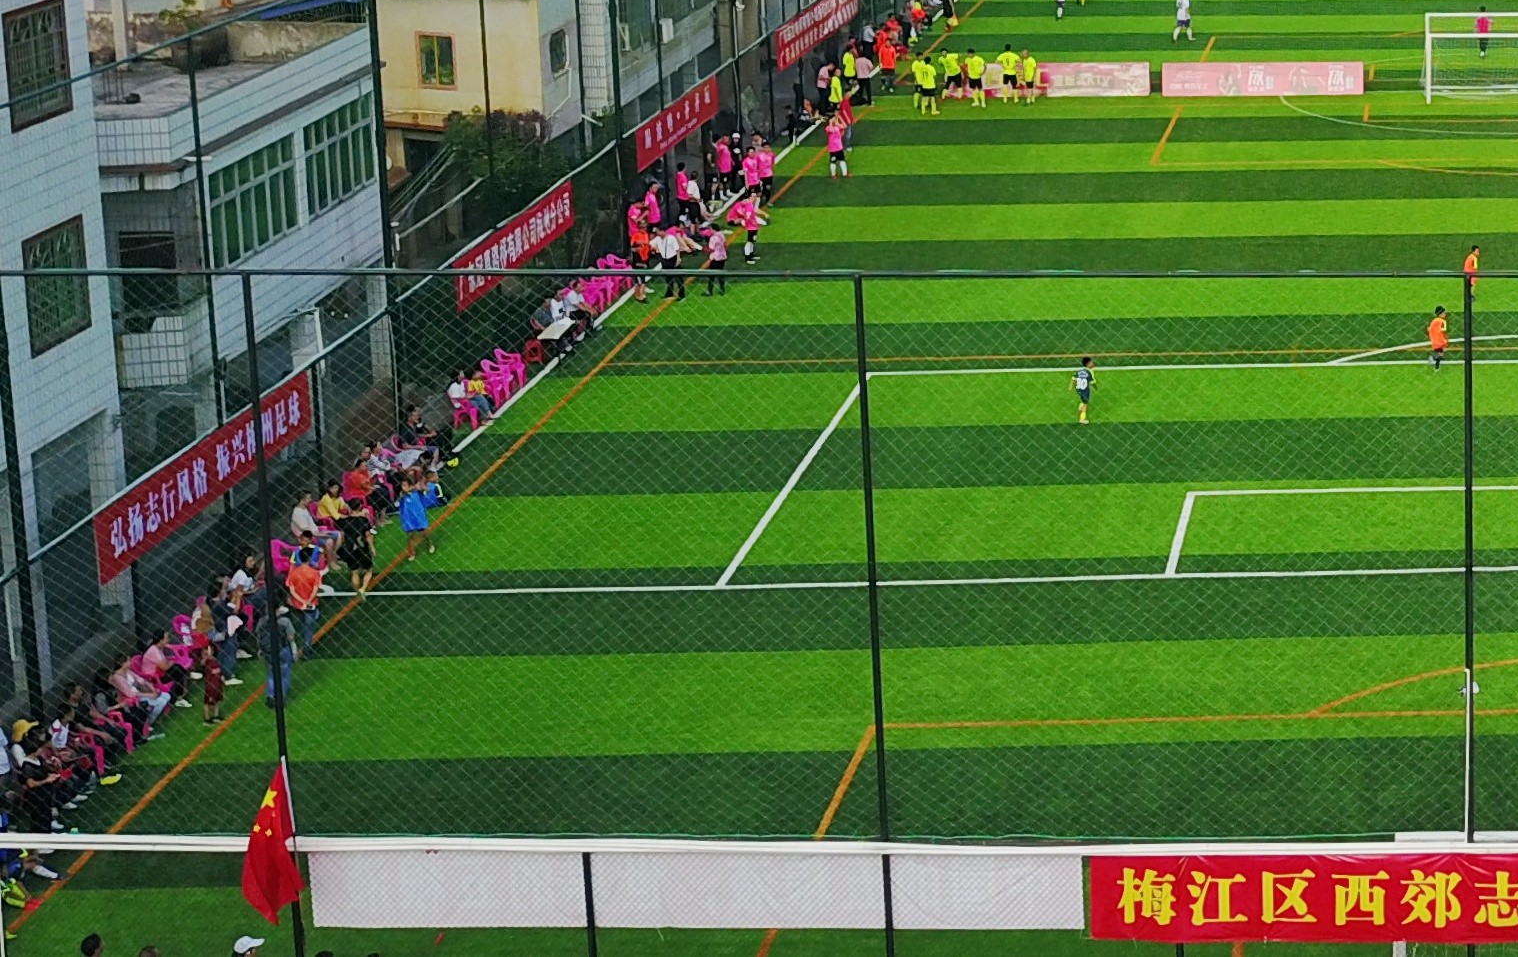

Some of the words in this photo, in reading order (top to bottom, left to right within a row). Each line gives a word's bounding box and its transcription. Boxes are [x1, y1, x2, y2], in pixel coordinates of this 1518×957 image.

[109, 457, 208, 559] 弘扬志行风格
